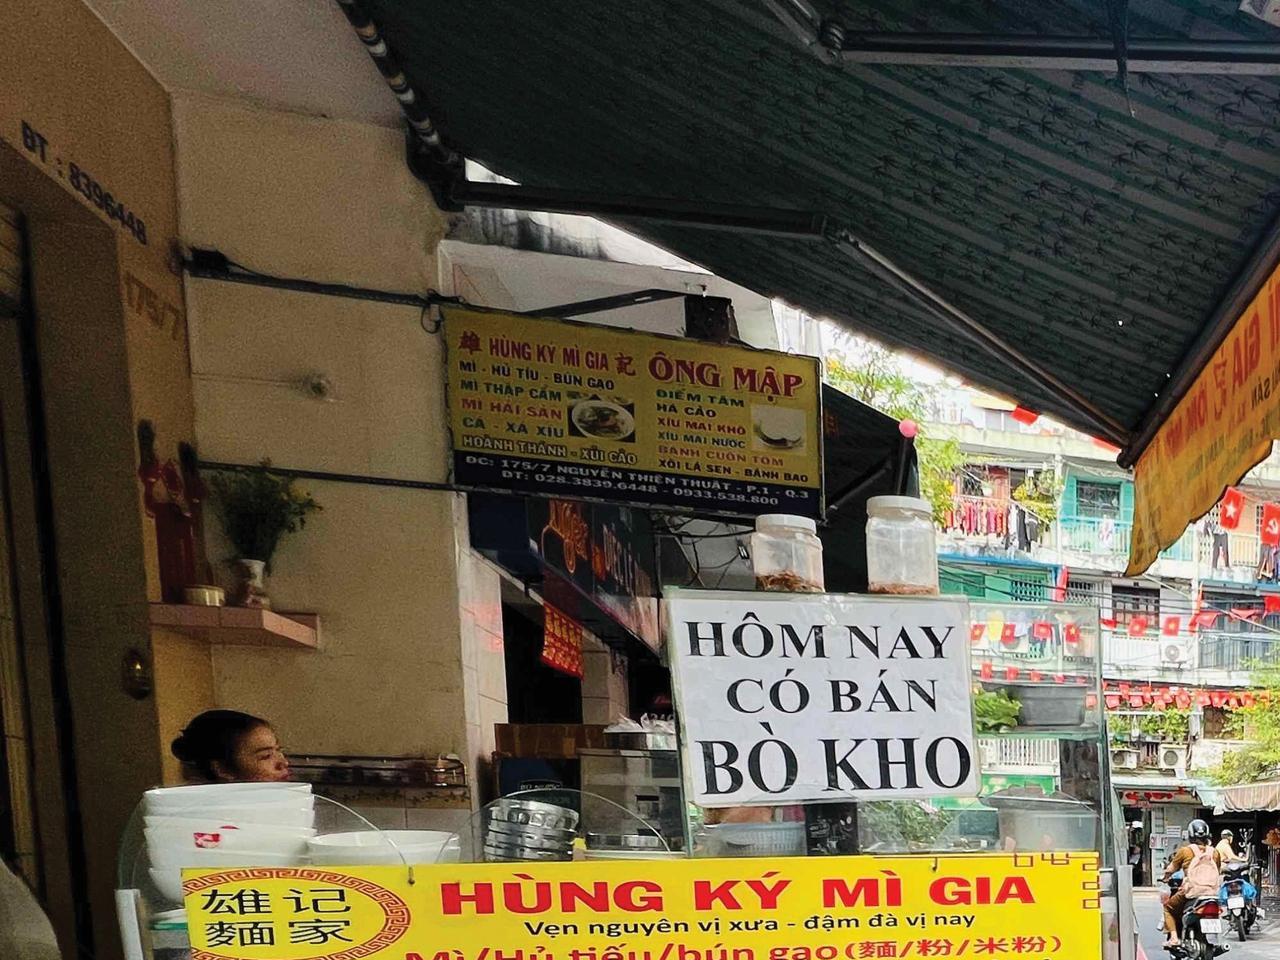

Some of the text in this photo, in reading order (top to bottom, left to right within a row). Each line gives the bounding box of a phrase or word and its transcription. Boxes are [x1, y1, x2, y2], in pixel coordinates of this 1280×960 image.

[489, 334, 532, 361] HÙNG
[562, 345, 580, 367] MÌ
[585, 350, 609, 371] GIA
[648, 351, 721, 388] ÔNG
[733, 365, 804, 402] MẬP
[706, 464, 732, 475] SEN
[784, 472, 809, 483] BAO
[683, 612, 955, 660] HÔM NAY
[726, 668, 939, 714] CÓ BÁN
[695, 721, 972, 795] BÒ KHO
[201, 888, 352, 915] 雄记
[440, 869, 1036, 915] HÙNG KÝ MÌ GIA
[204, 918, 354, 948] 麵家
[523, 912, 976, 939] Vẹn nguyên vị xưa đậm đà vị nay
